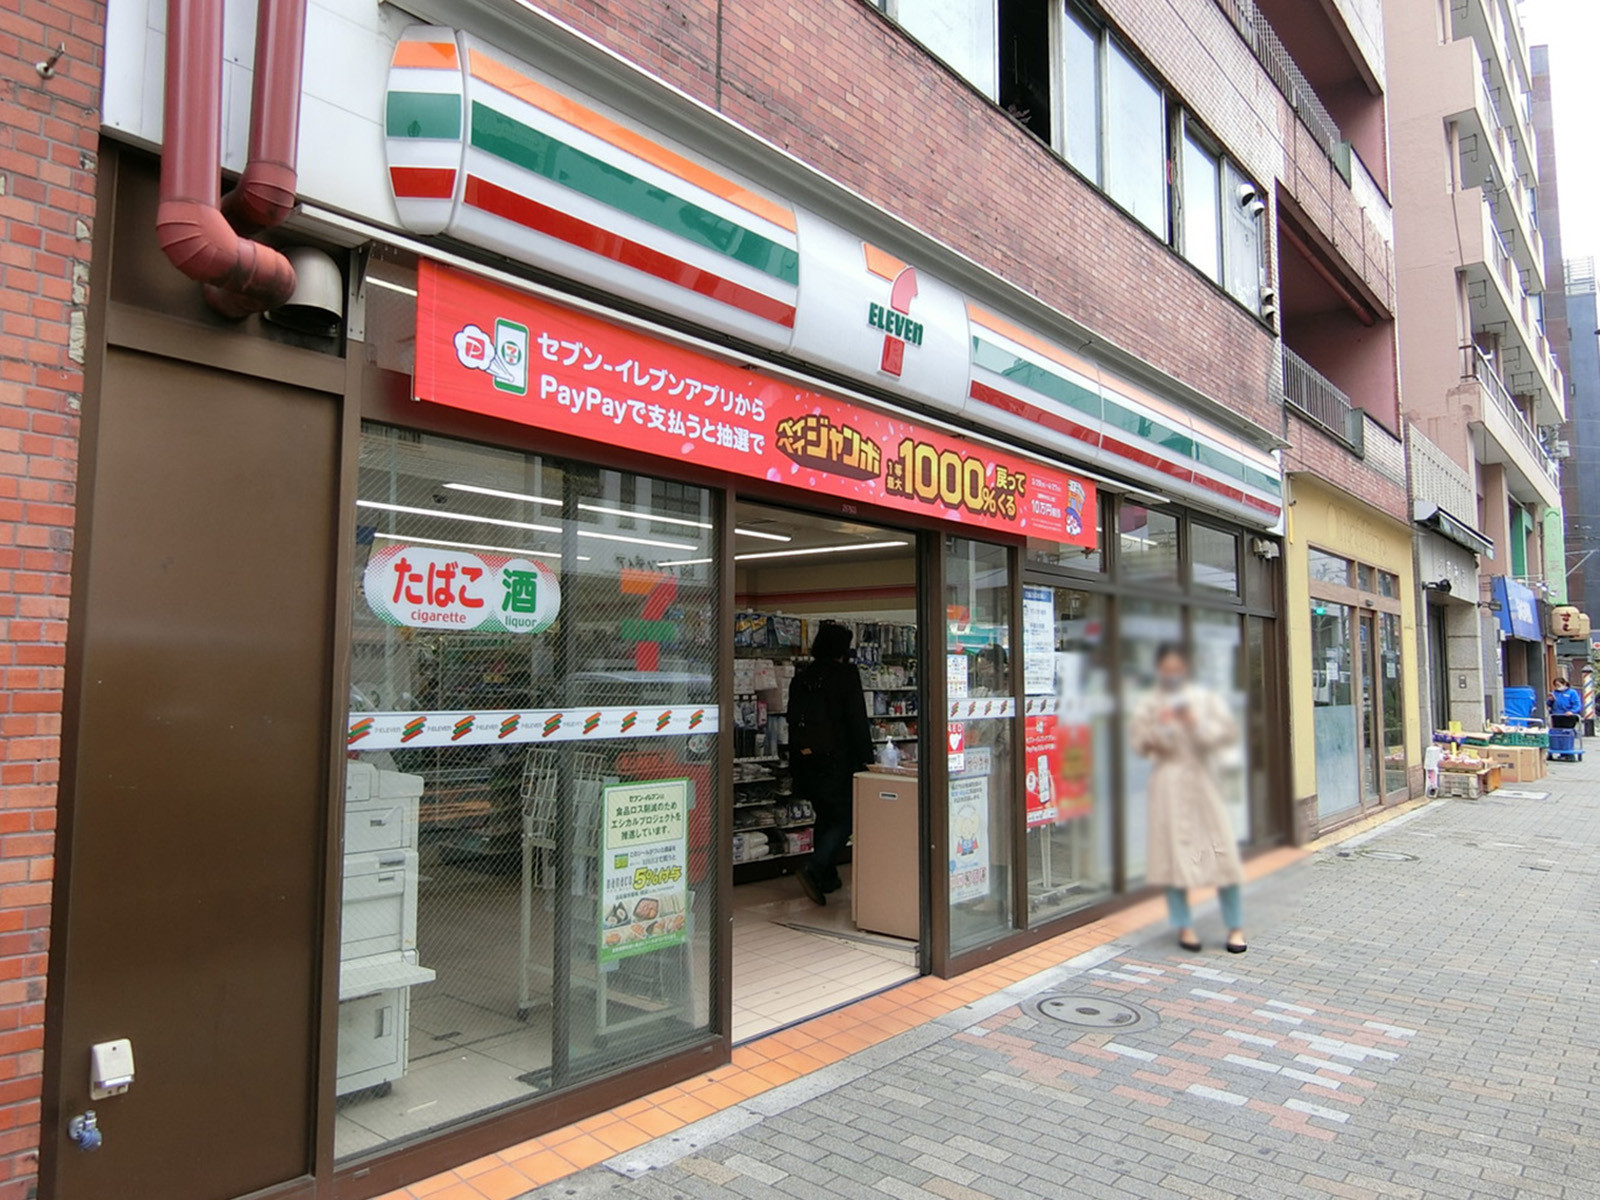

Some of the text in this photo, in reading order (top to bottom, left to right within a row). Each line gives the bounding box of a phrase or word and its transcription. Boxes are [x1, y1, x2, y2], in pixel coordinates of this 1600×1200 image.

[540, 374, 766, 456] PayPayで支払うと抽選で
[886, 476, 903, 491] 最大
[995, 466, 1027, 494] 戻って
[998, 493, 1017, 518] くる
[392, 557, 485, 609] たばこ
[501, 567, 538, 614] 酒
[410, 609, 467, 624] cigarette
[504, 615, 538, 629] liquor
[616, 802, 678, 817] 食品ロス削減のため
[611, 812, 682, 830] エシカルプロジェクトを
